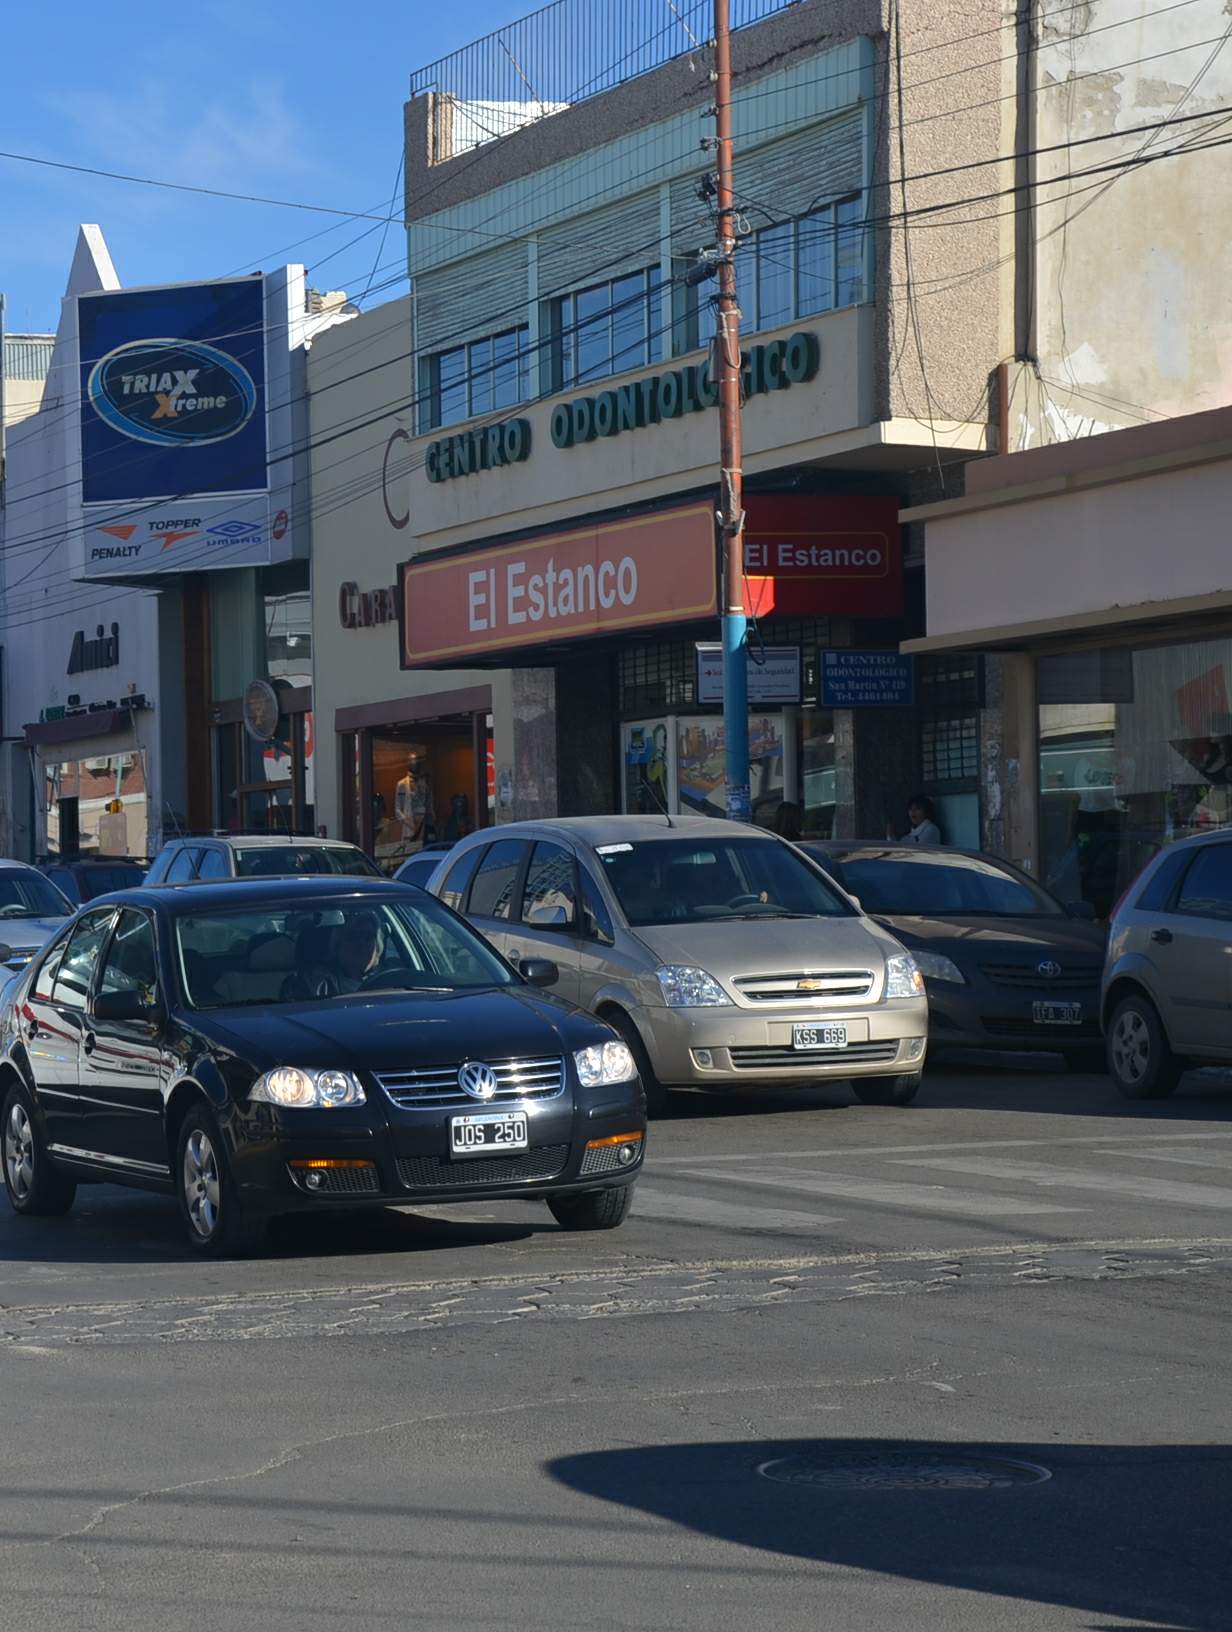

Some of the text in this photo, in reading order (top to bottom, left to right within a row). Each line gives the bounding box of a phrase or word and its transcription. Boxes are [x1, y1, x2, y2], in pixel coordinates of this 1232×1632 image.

[122, 369, 200, 396] TRIAX
[151, 393, 227, 419] Xtreme
[425, 332, 820, 483] CENTRO ODONTOLOICO
[148, 518, 201, 530] TOPPER
[91, 545, 142, 559] PENALTY
[743, 543, 881, 567] El Estanco
[468, 556, 638, 632] El Estanco
[840, 655, 896, 665] CENTRO
[796, 1028, 845, 1044] KSS 669
[494, 1121, 524, 1143] 250
